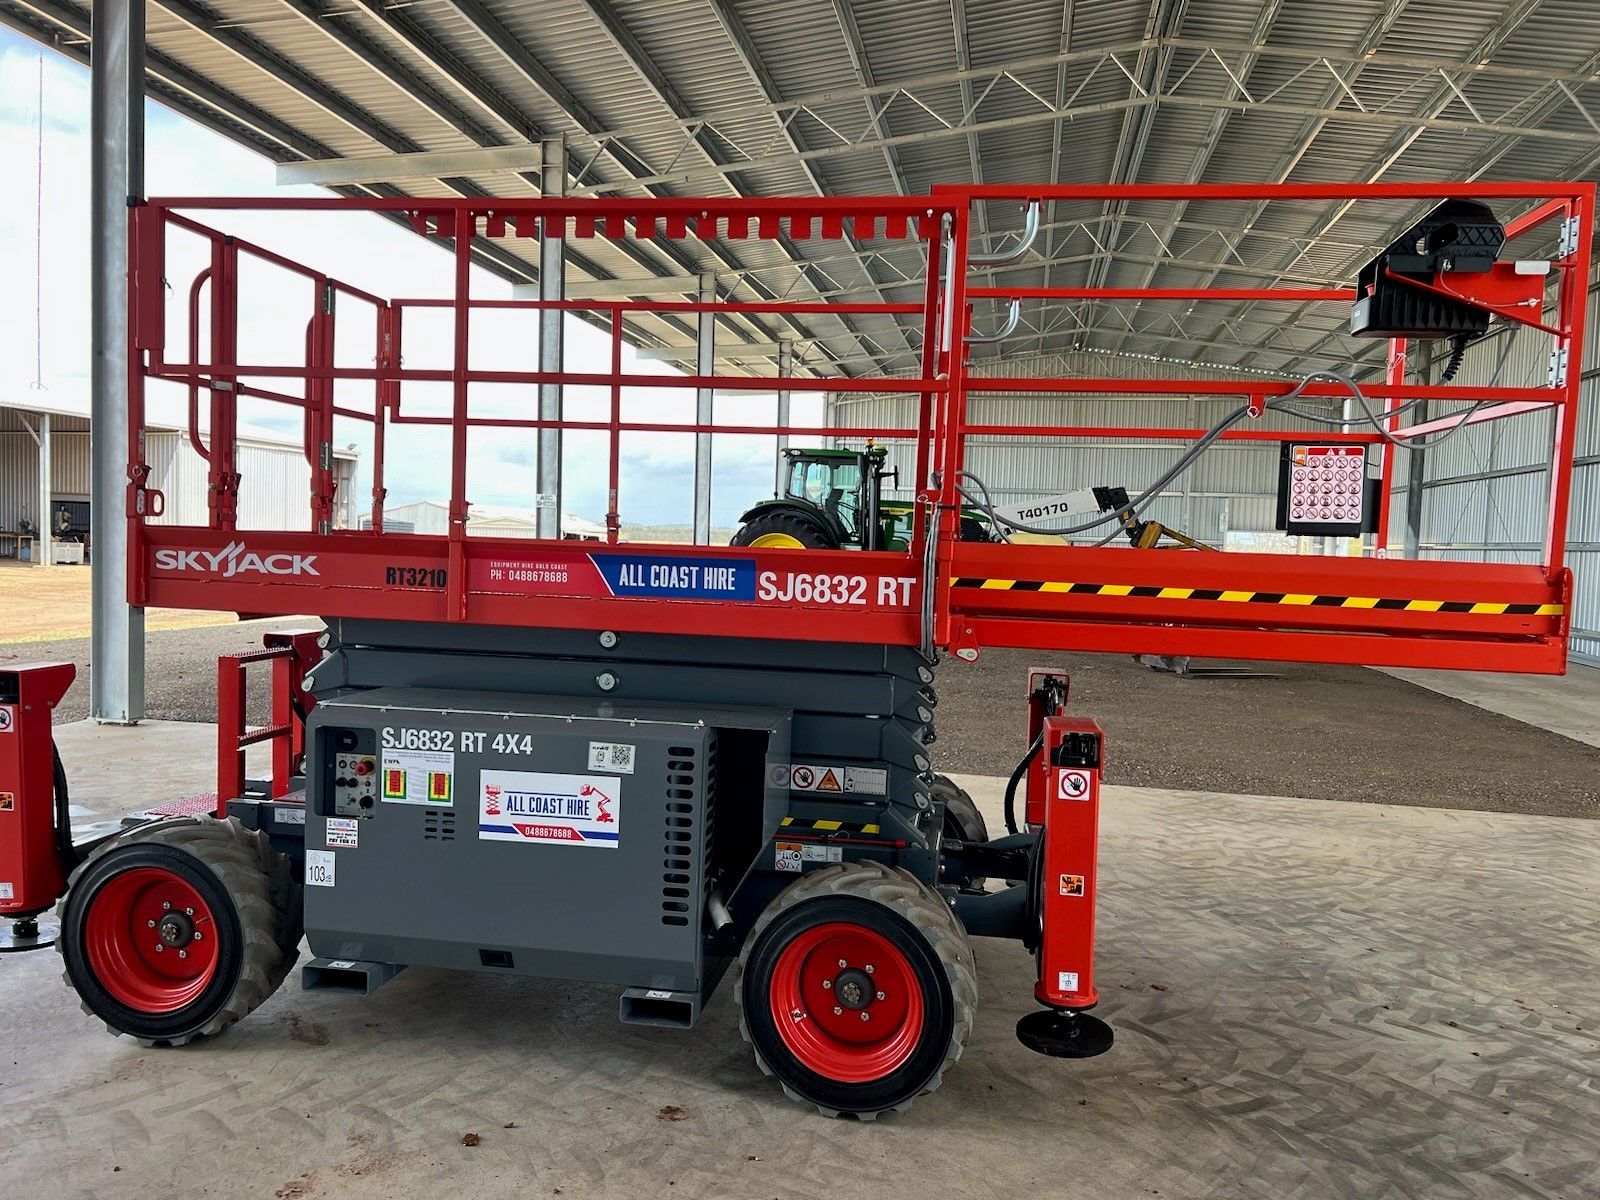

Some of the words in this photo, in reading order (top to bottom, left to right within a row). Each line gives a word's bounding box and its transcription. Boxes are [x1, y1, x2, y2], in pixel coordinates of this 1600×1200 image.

[1017, 502, 1069, 520] T40170
[155, 541, 321, 577] SKYJACK
[490, 561, 521, 569] EQUIPMENT
[386, 567, 447, 588] RT3210
[490, 569, 506, 580] PH:
[508, 570, 568, 583] 0488678688
[619, 564, 646, 587] ALL
[650, 565, 699, 589] COAST
[703, 567, 736, 591] HIRE
[758, 571, 868, 605] SJ6832
[877, 576, 917, 607] RT
[381, 727, 454, 751] SJ6832
[460, 732, 488, 754] RT
[491, 733, 533, 755] 4X4
[506, 794, 526, 813] ALL
[528, 796, 564, 816] COAST
[567, 798, 590, 817] HIRE
[525, 826, 572, 838] 0488678688
[309, 865, 326, 882] 103
